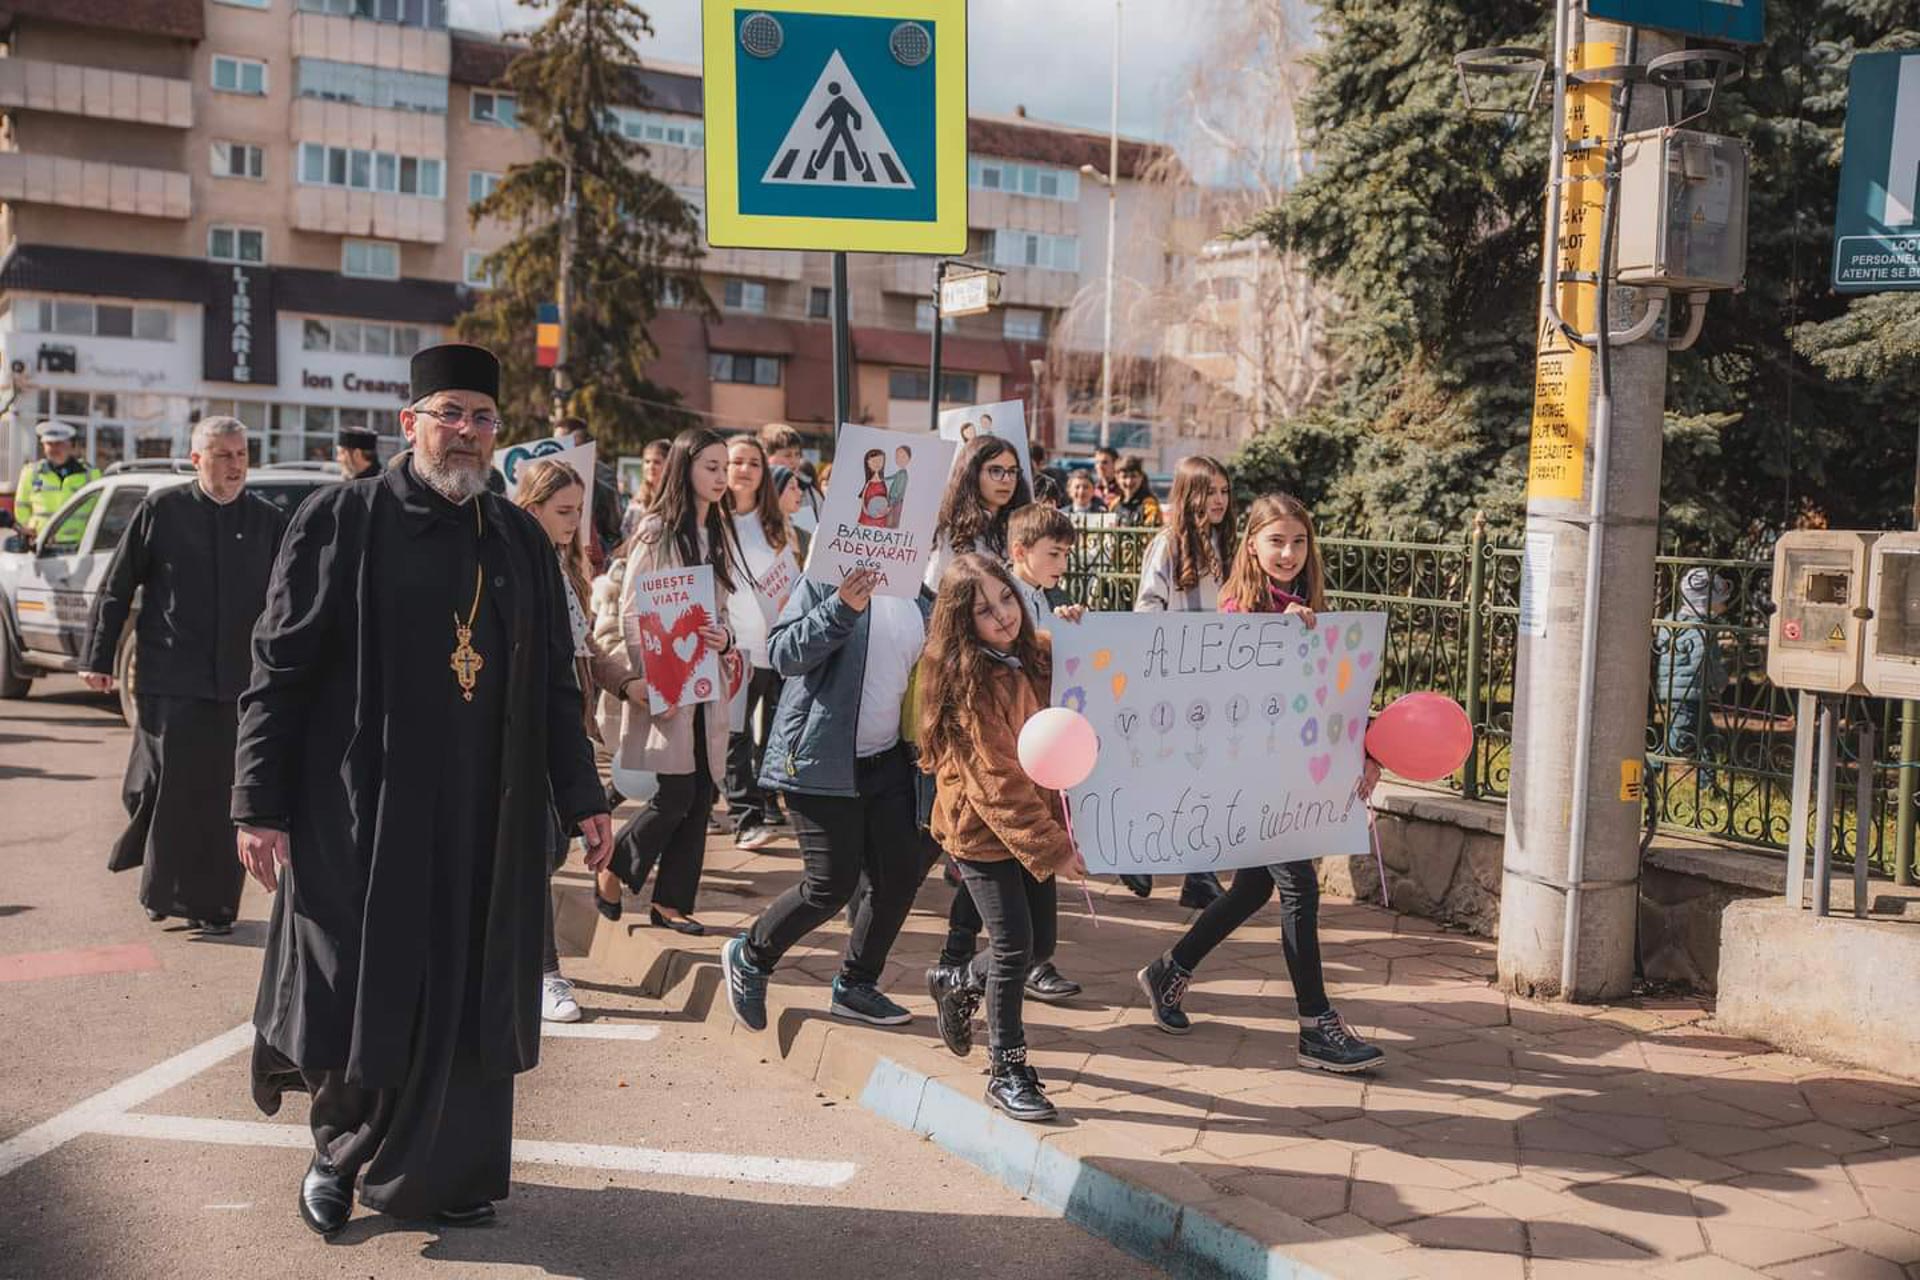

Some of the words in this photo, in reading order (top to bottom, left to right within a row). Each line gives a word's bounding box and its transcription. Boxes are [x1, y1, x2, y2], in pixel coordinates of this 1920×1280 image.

[1892, 240, 1917, 251] LOC
[1891, 267, 1906, 278] SE
[302, 369, 333, 389] Ion
[343, 373, 411, 400] Creang
[1143, 620, 1290, 678] ALEGE
